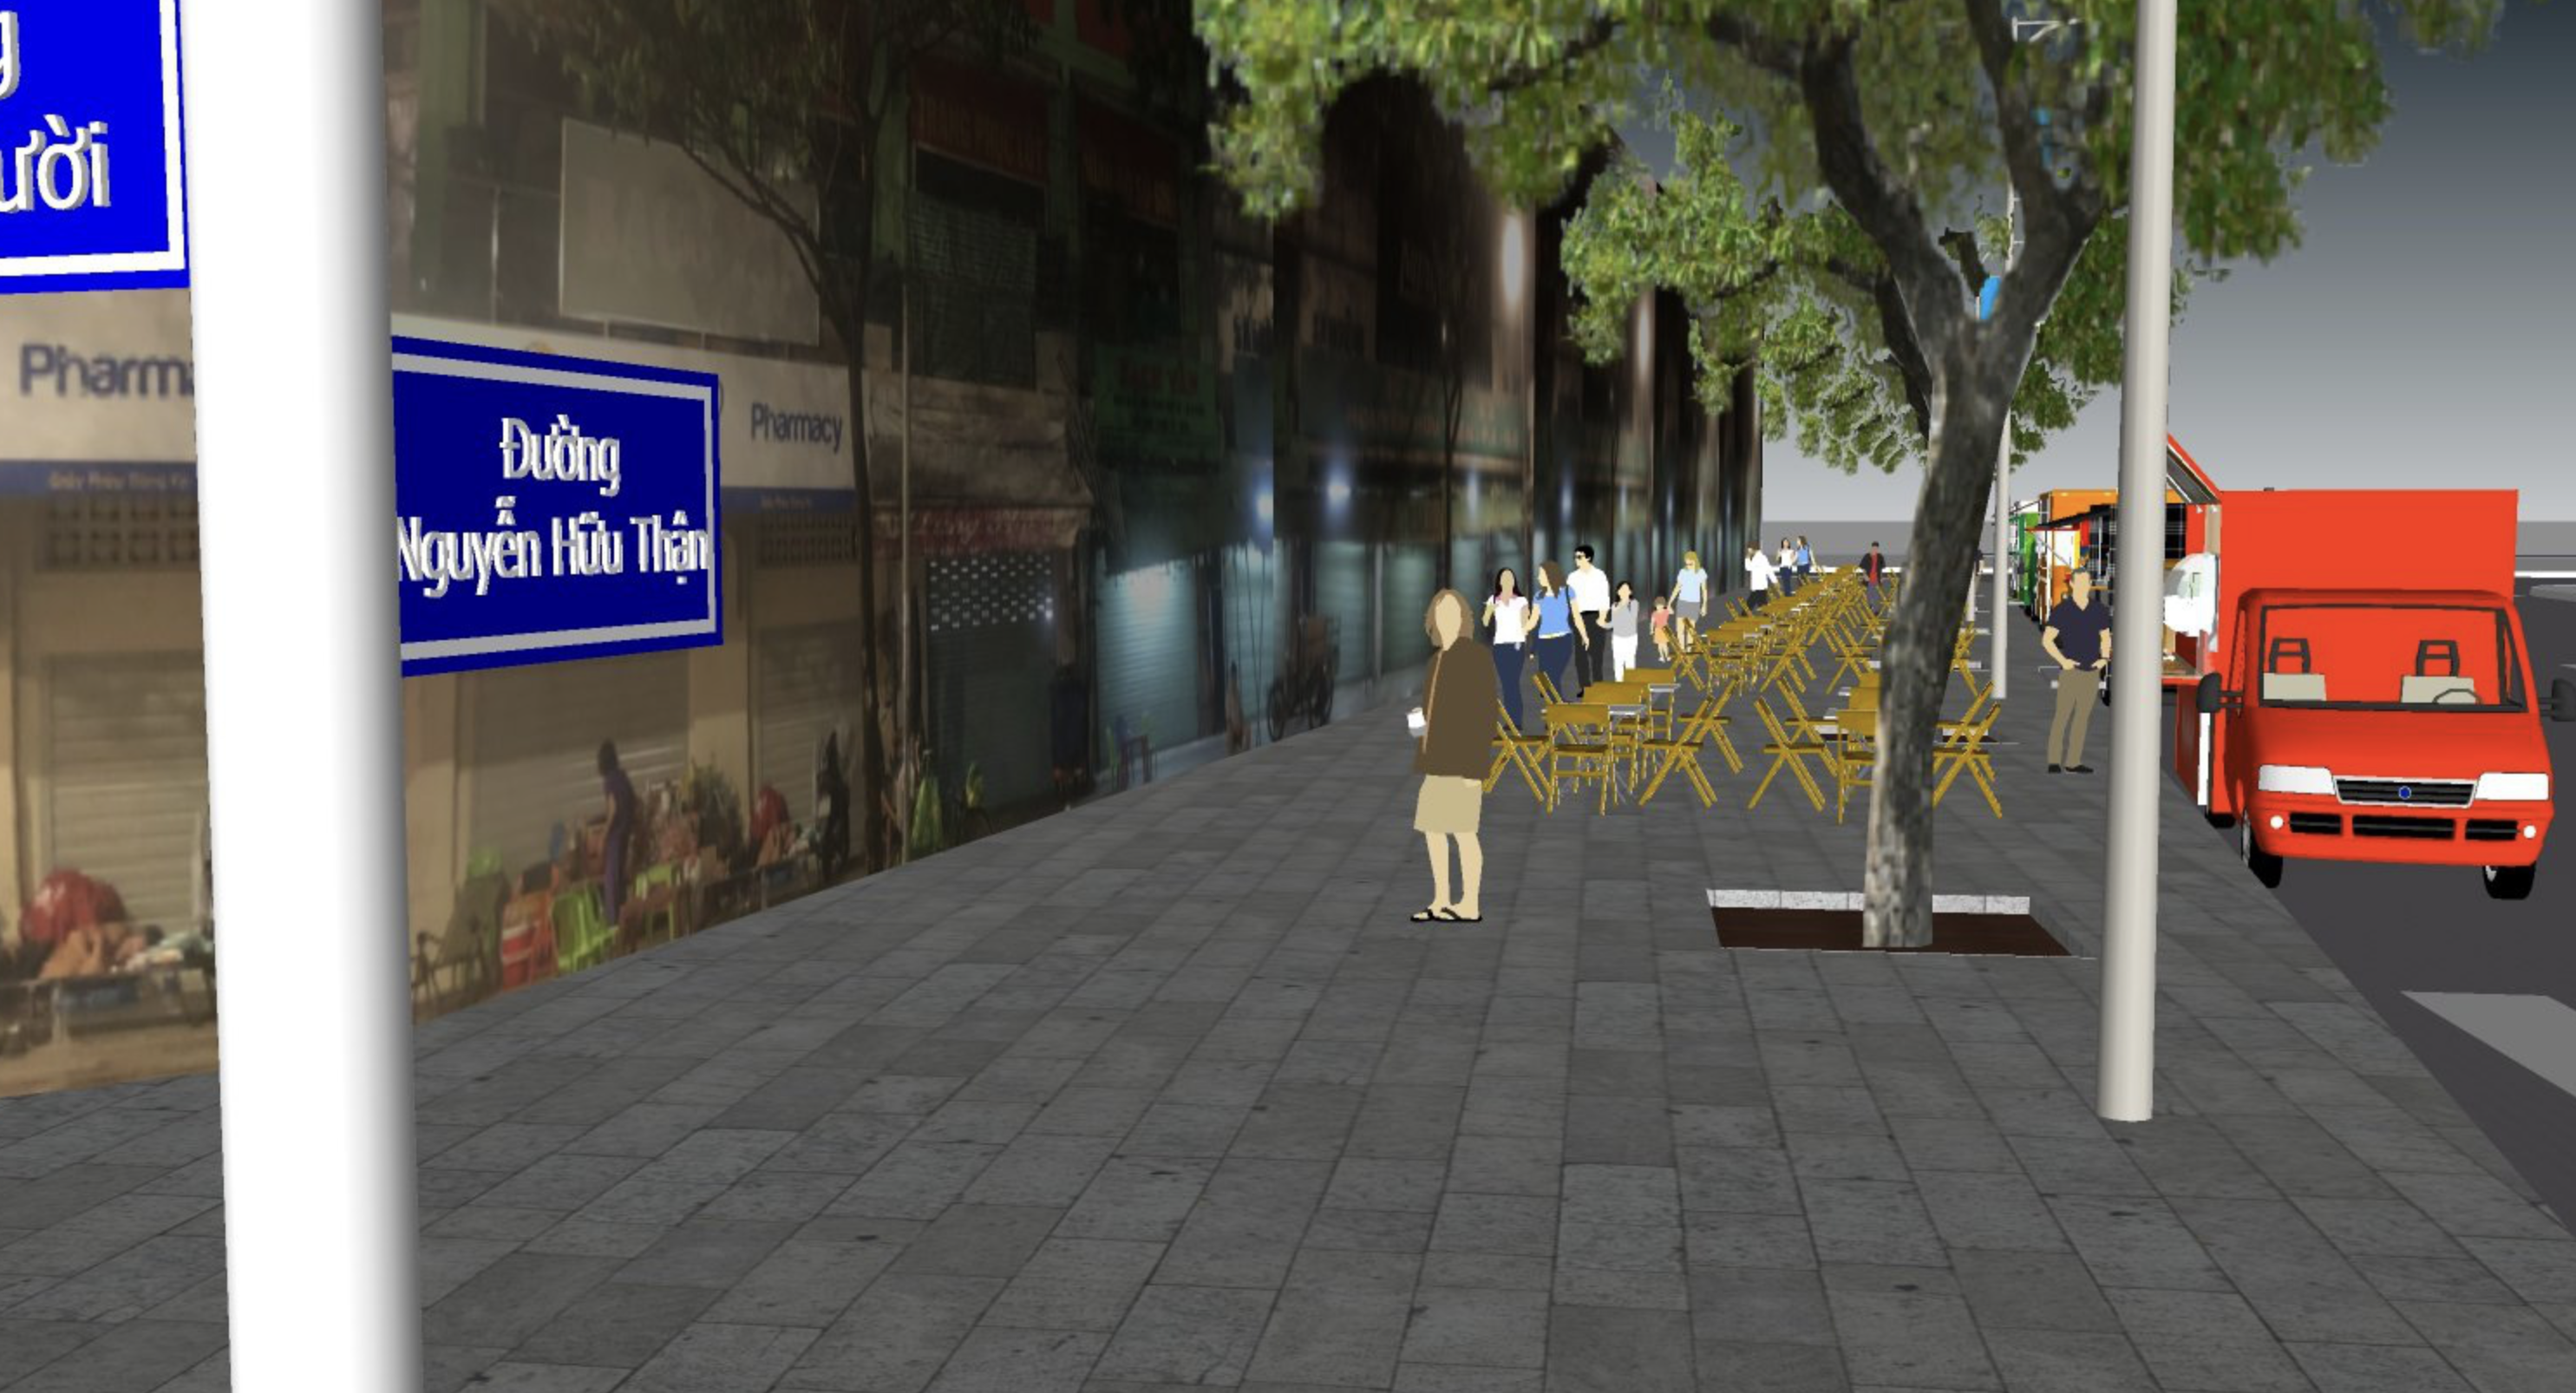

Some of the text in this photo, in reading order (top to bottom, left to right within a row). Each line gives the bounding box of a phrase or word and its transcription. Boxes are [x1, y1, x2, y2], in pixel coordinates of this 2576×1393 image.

[20, 343, 194, 397] Pharm
[500, 414, 621, 496] Đường
[751, 402, 842, 455] Pharmacy
[397, 495, 709, 598] Nguyễn Hữu Thận
